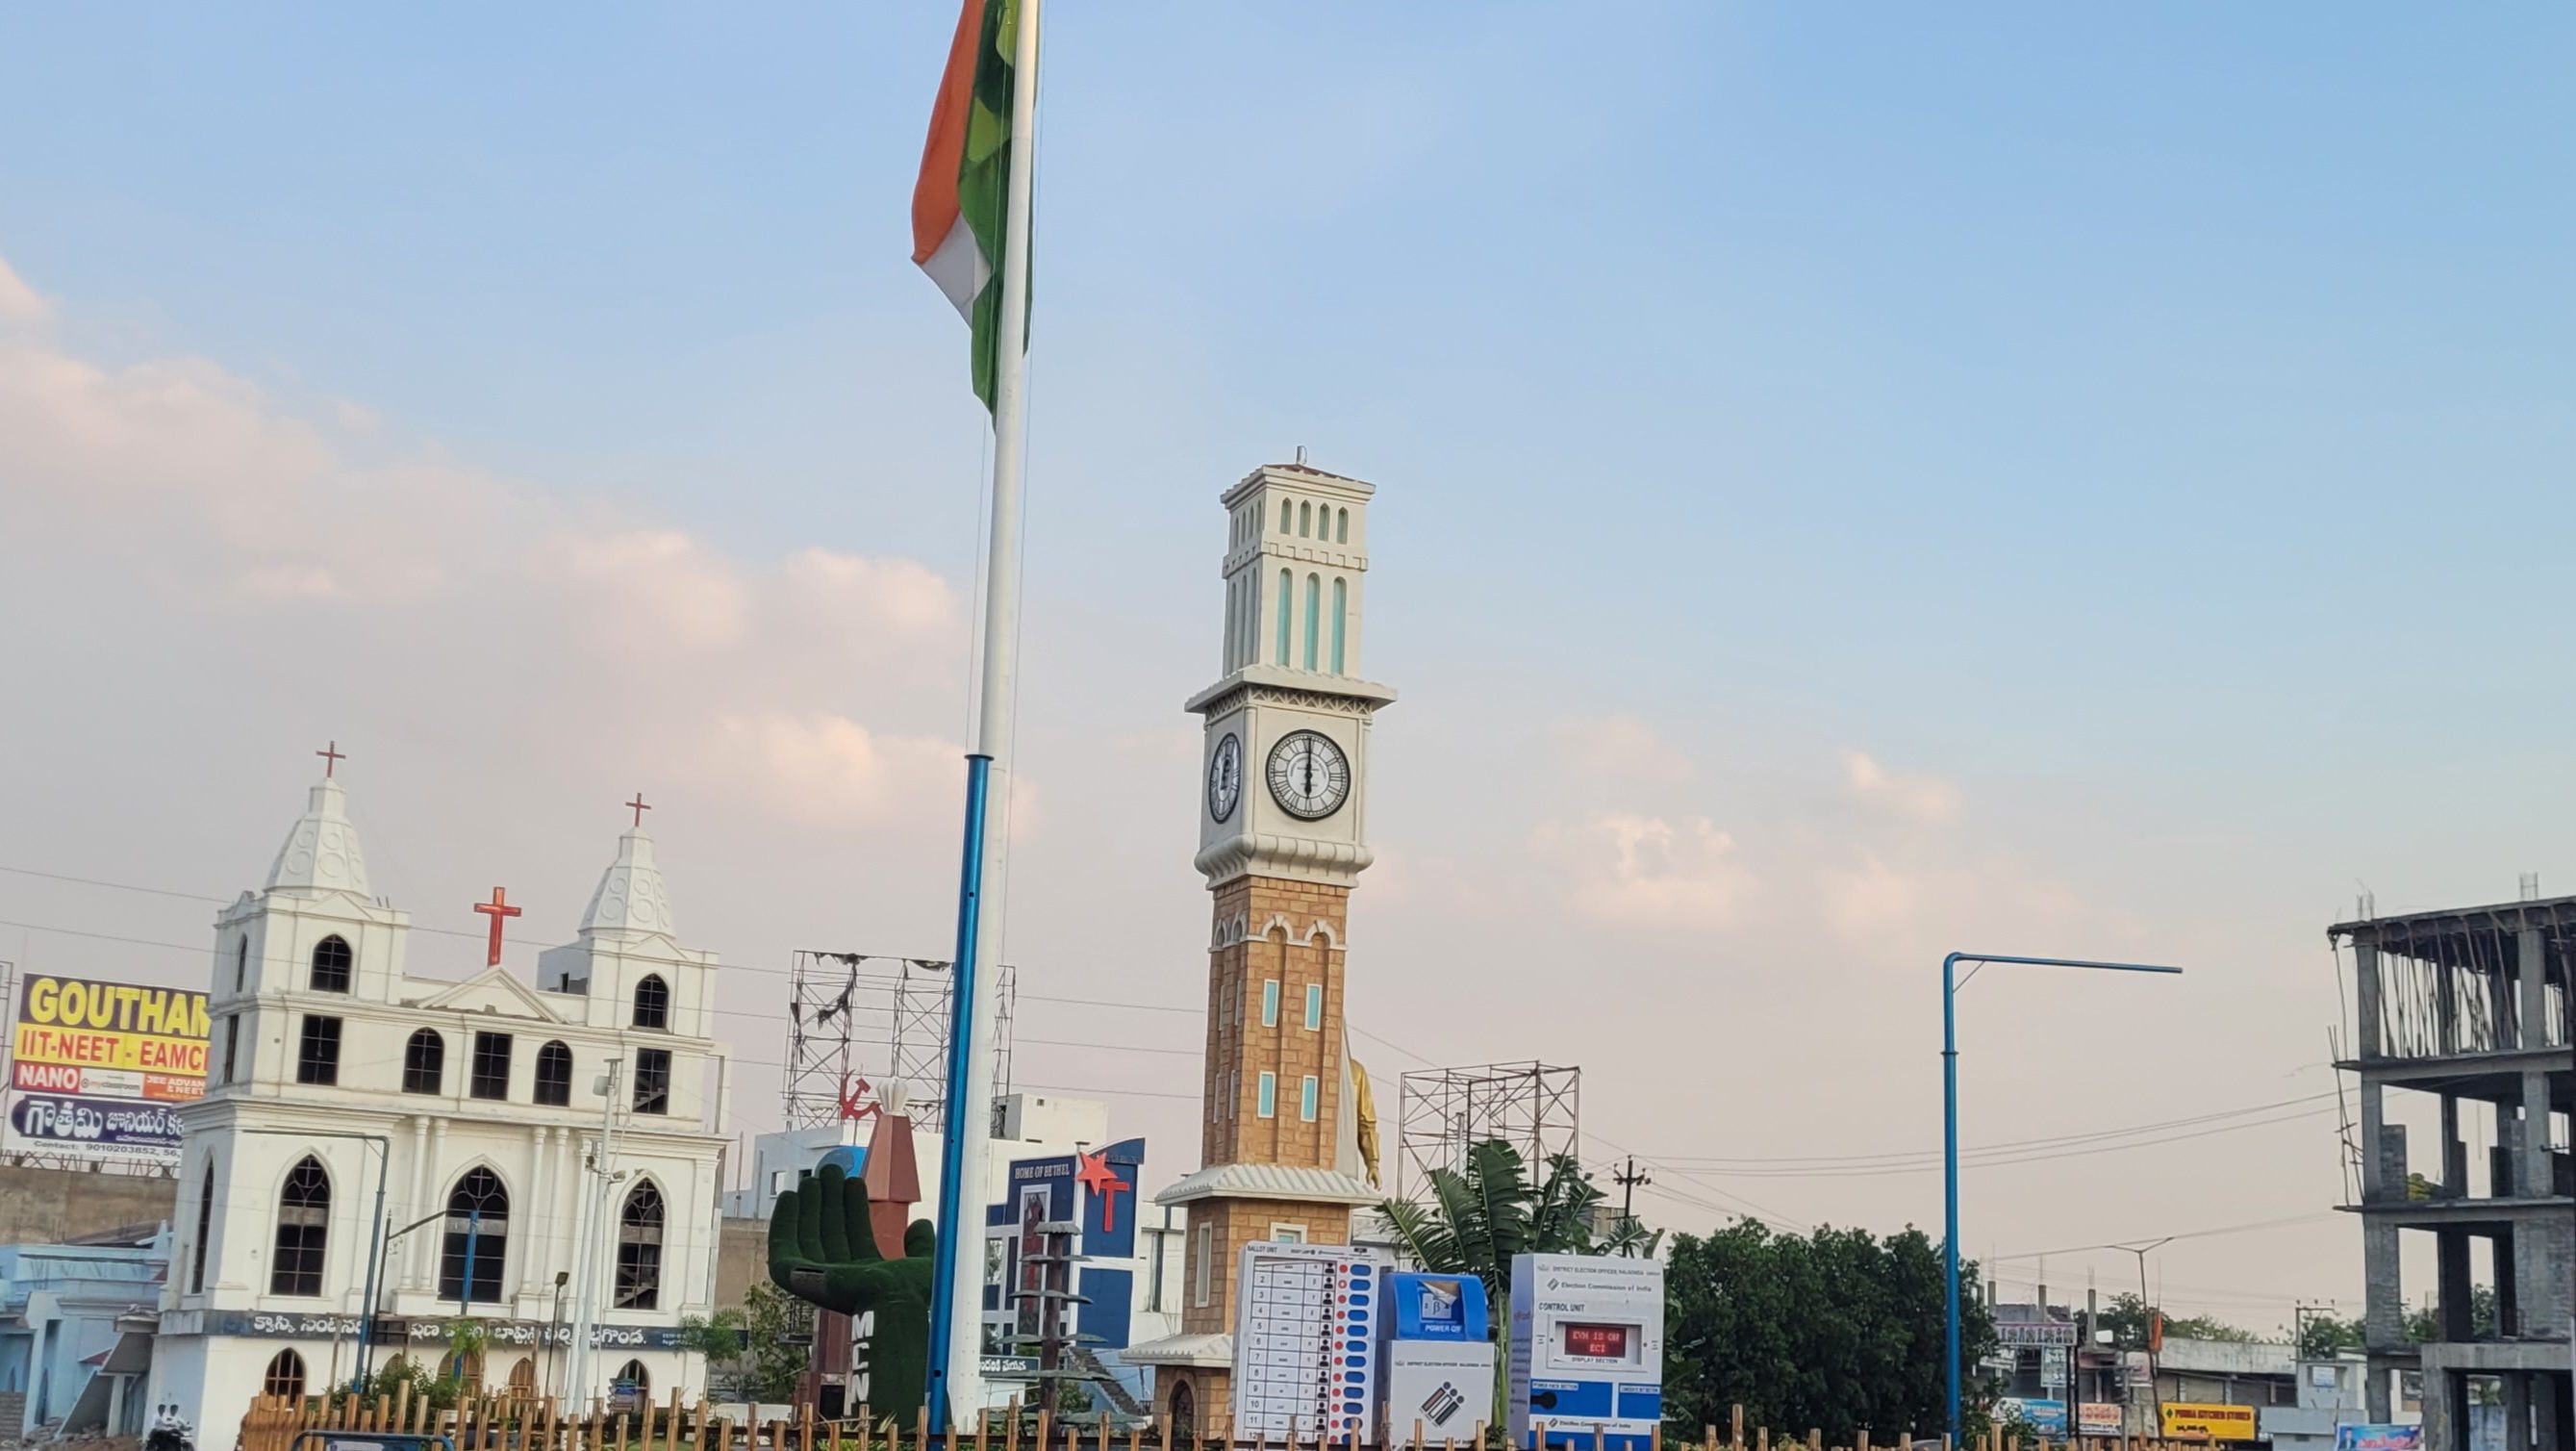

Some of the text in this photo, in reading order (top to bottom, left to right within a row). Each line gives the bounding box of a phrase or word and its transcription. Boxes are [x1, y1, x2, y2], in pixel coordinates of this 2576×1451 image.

[21, 1030, 119, 1063] IIT-NEET
[18, 1064, 78, 1090] NANO
[146, 1075, 166, 1085] JEE
[34, 1139, 79, 1151] Contact:
[1539, 1302, 1585, 1312] CONTROL UNIT
[1590, 1344, 1605, 1353] ECI
[1250, 1400, 1260, 1409] 10
